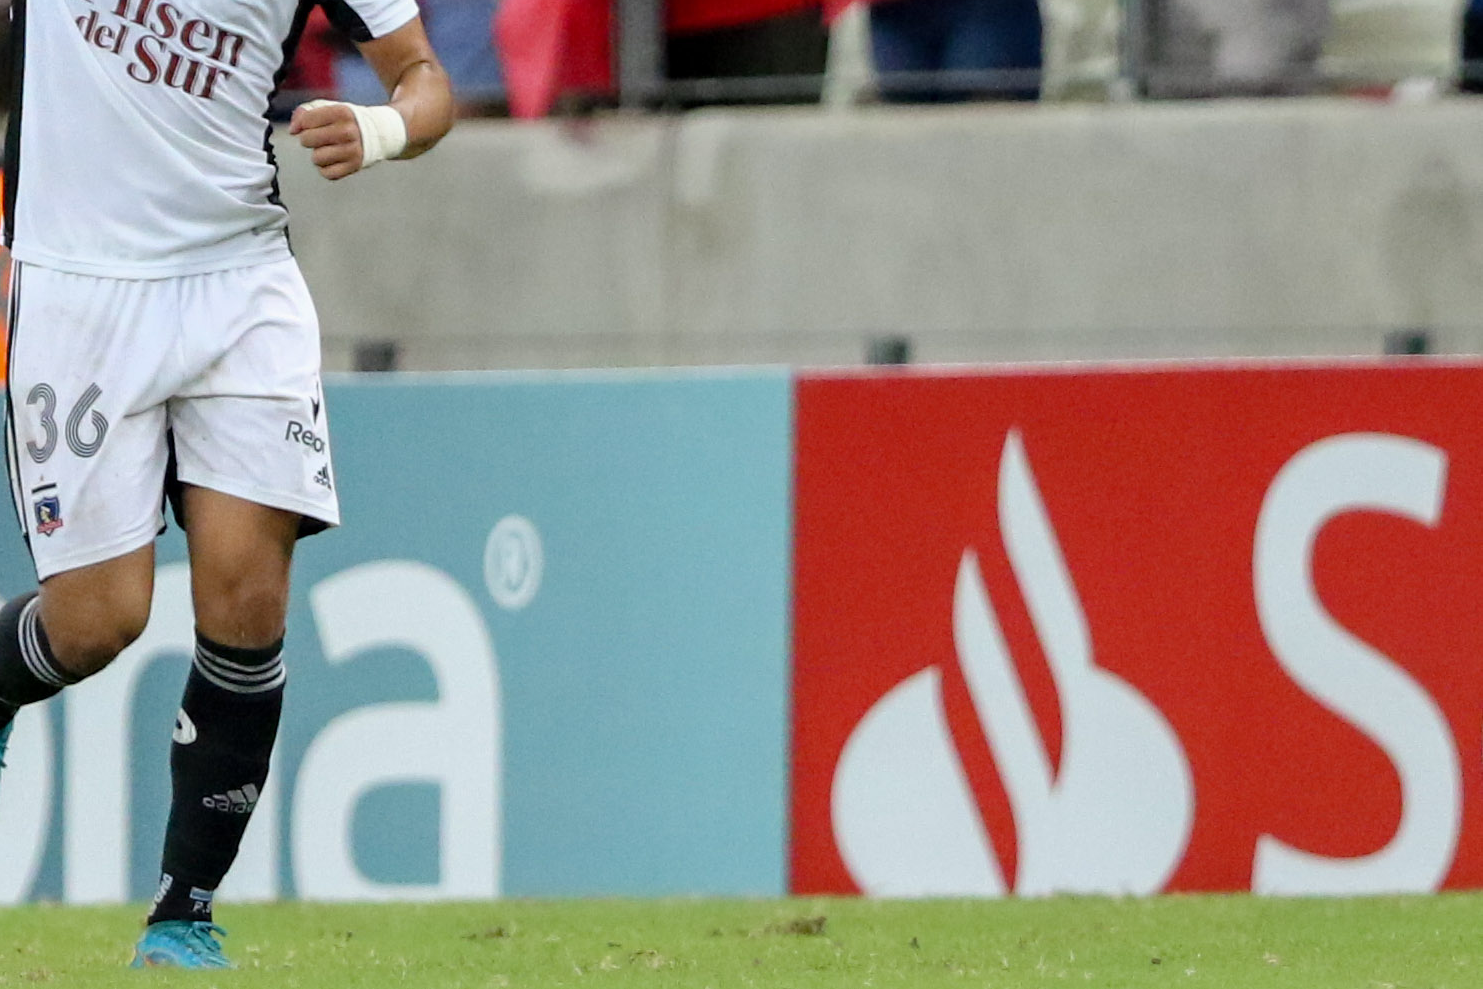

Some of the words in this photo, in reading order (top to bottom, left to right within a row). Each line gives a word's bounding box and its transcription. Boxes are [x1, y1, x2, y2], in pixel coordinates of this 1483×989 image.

[75, 10, 130, 55] del
[126, 34, 232, 99] Sur
[26, 382, 110, 463] 36
